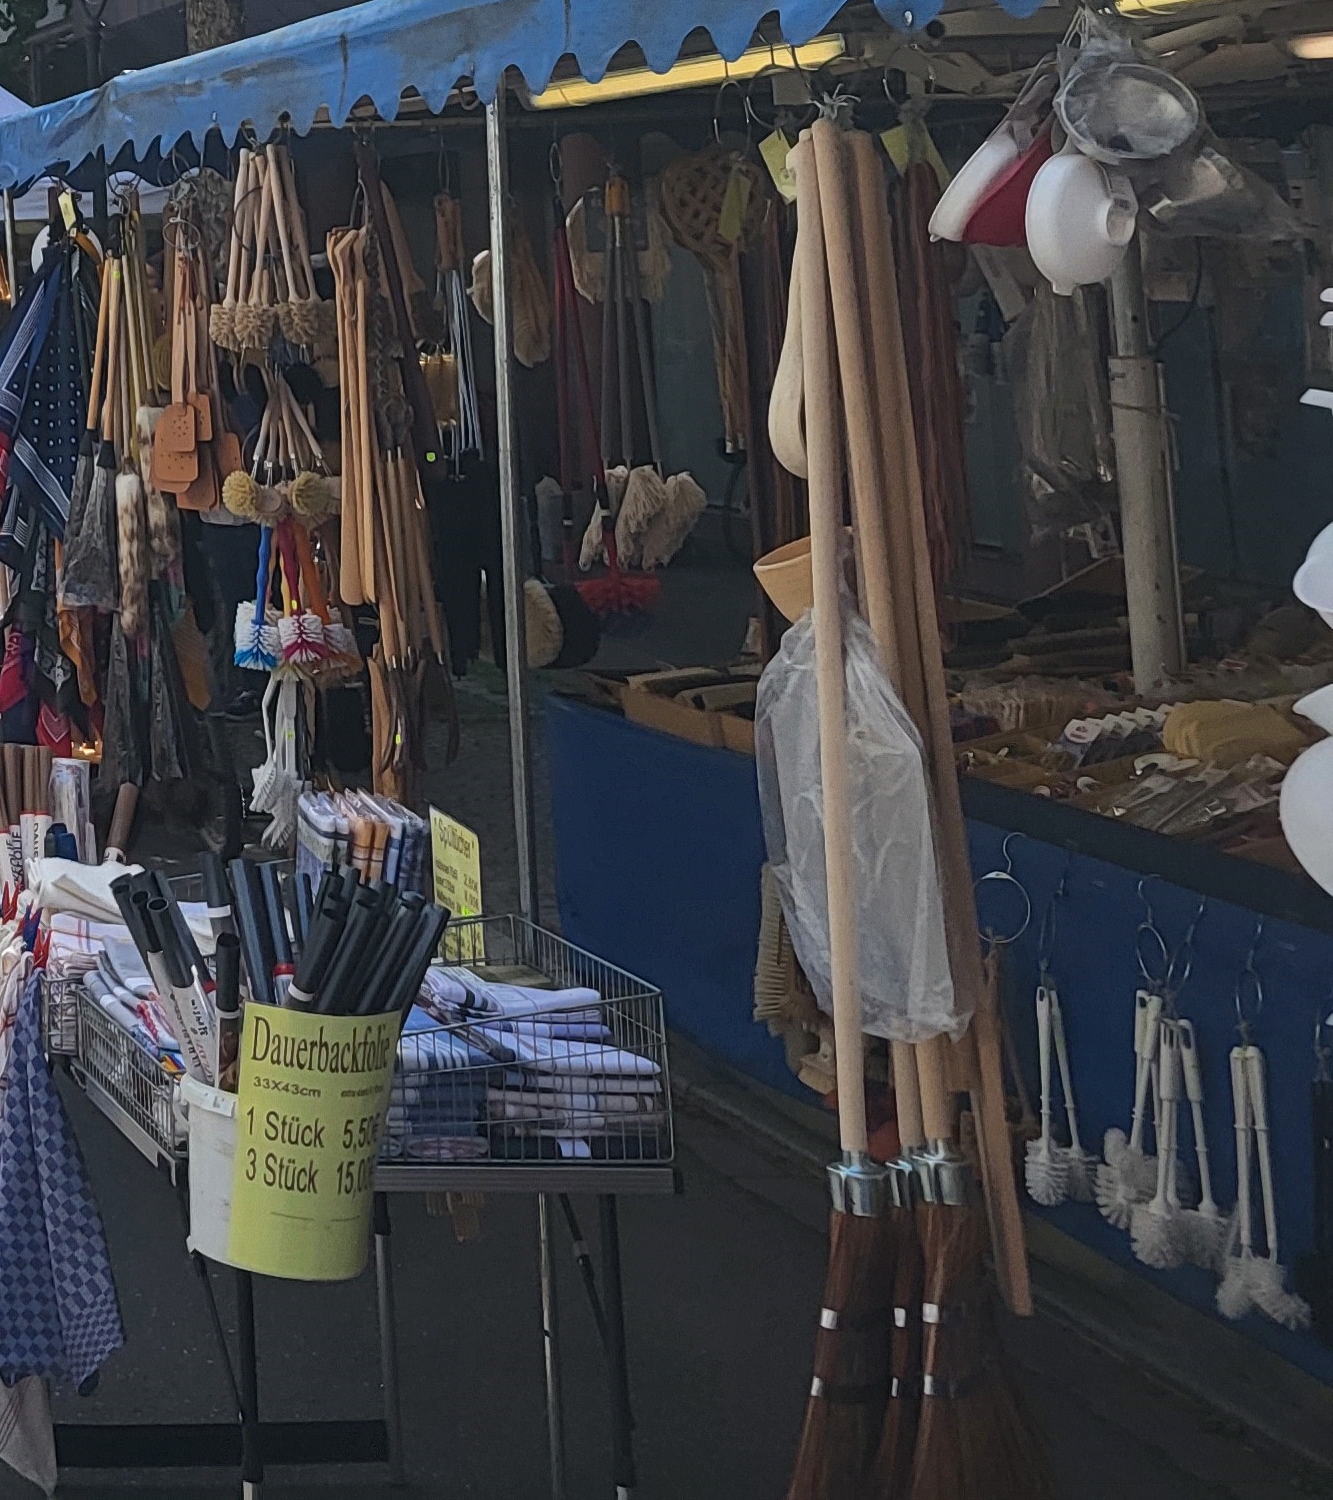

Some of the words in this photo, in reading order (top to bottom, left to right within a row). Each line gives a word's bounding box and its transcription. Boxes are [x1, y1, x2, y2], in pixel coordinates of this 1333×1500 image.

[250, 1015, 391, 1074] Dauerbackfolie
[253, 1075, 322, 1098] 33X43cm
[246, 1106, 255, 1136] 1
[264, 1110, 326, 1149] Stück
[245, 1147, 257, 1182] 3
[262, 1152, 320, 1195] Stück
